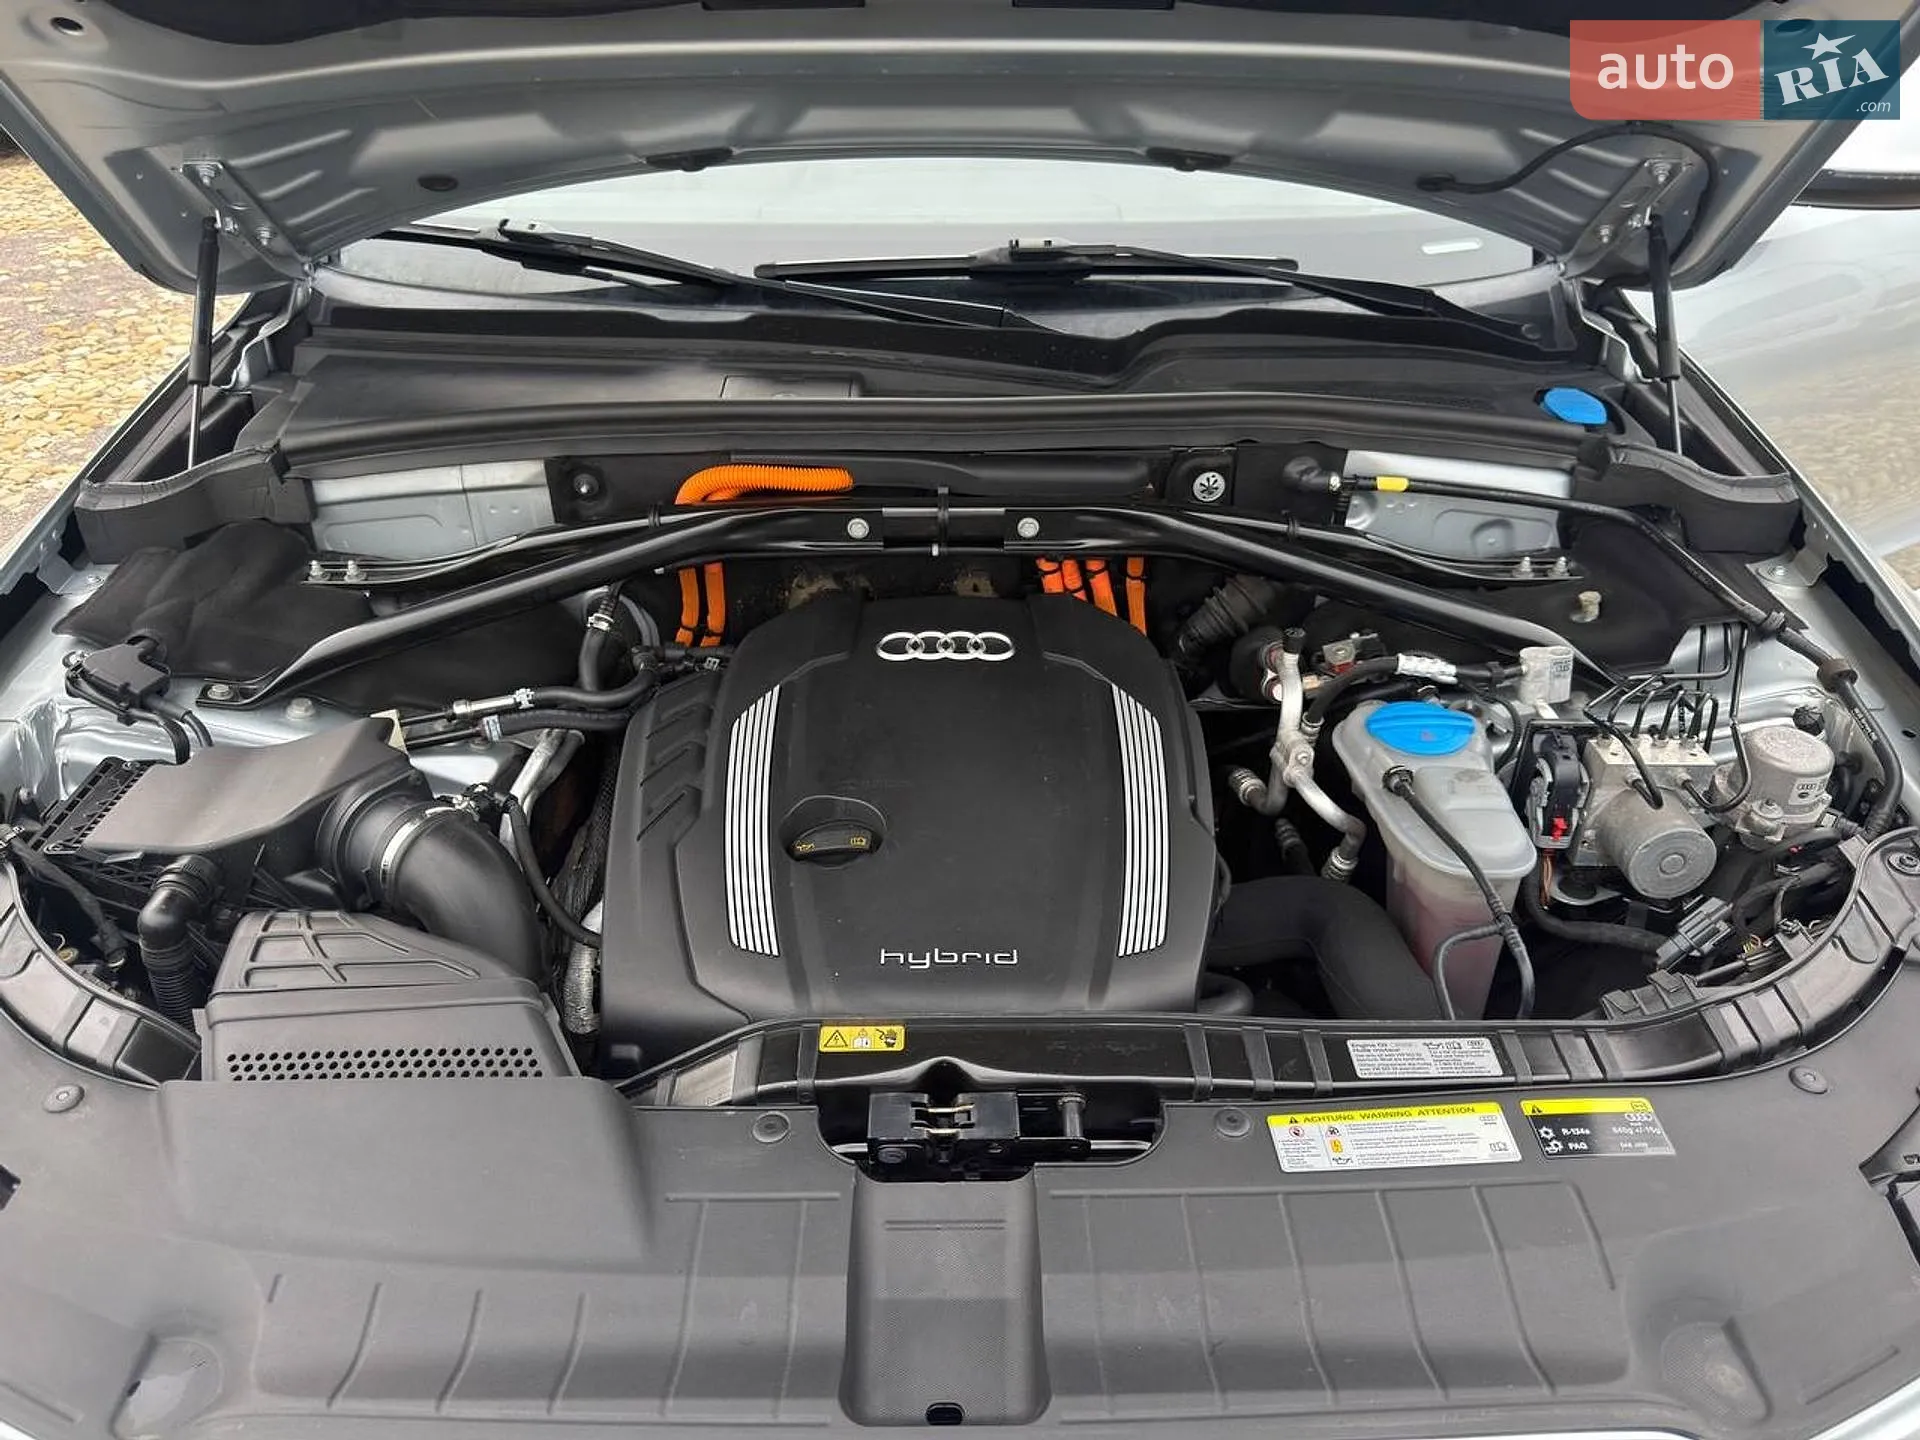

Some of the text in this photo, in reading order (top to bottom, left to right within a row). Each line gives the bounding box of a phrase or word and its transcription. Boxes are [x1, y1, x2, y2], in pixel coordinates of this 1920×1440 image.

[880, 948, 1018, 969] hybrid
[1303, 1106, 1476, 1124] ACHTUNG WARNING ATTENTION
